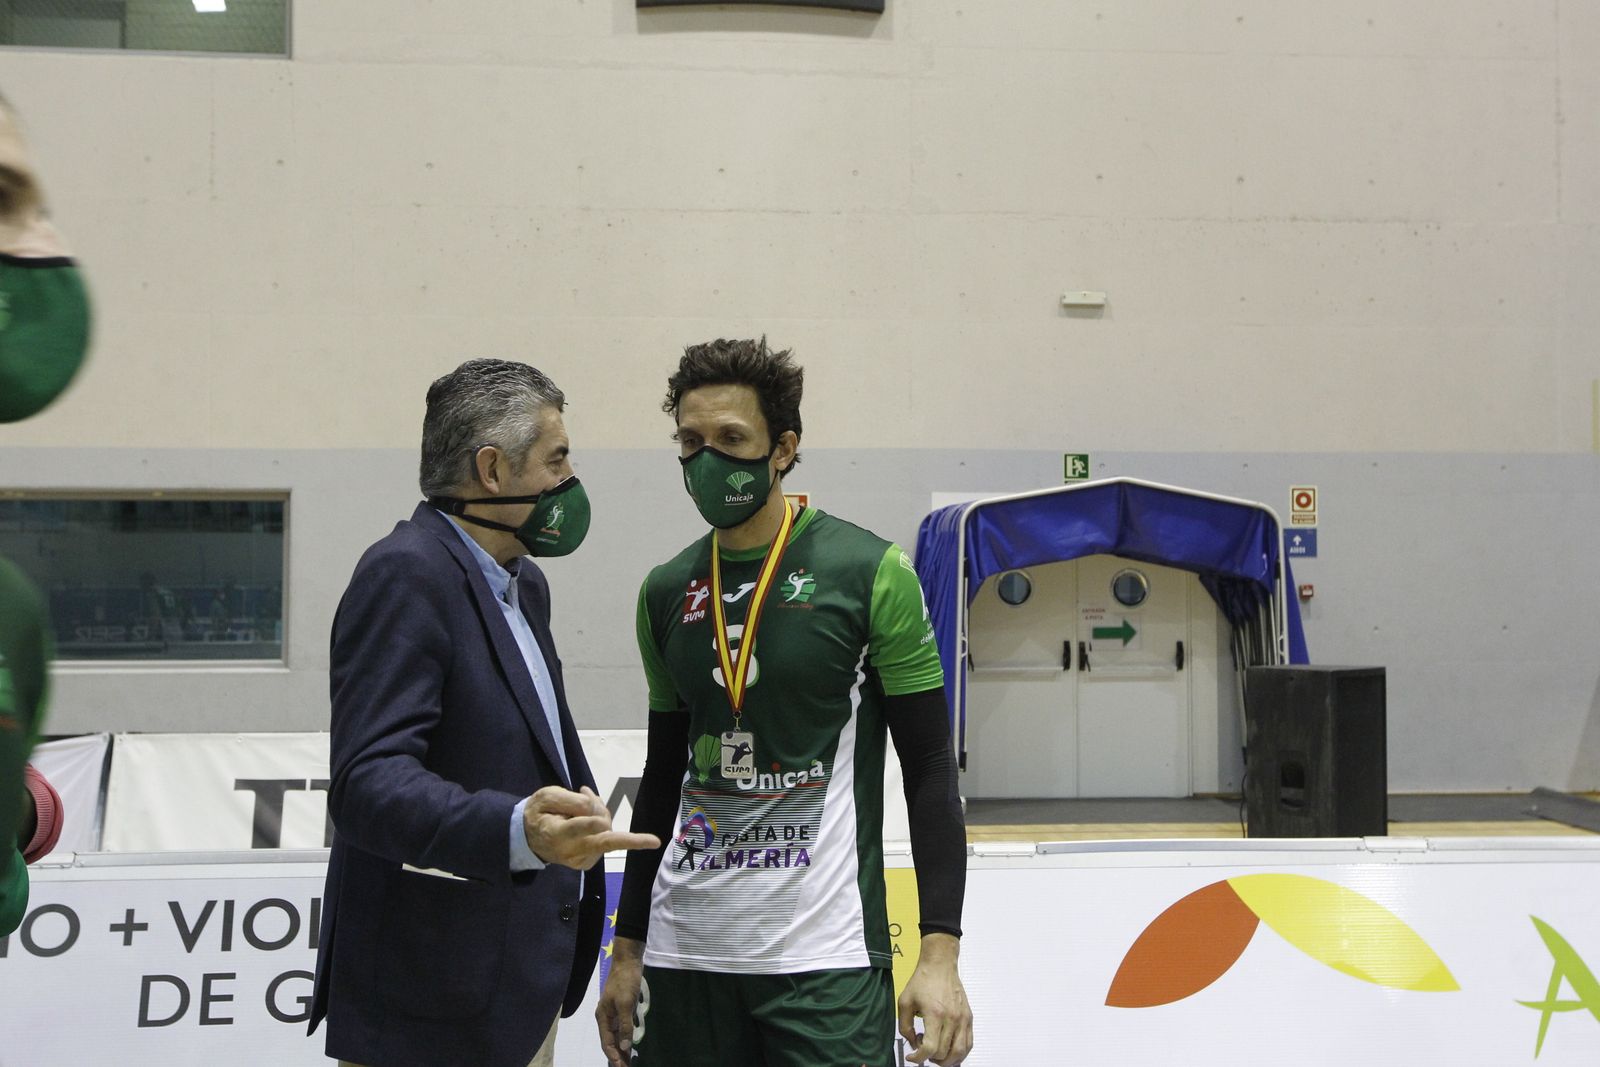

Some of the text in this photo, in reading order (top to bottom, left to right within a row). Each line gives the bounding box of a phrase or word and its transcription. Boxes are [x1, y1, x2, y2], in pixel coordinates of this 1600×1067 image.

[725, 493, 754, 502] Unicaja
[683, 610, 705, 623] SVM
[784, 825, 810, 840] DE
[138, 972, 236, 1027] DE
